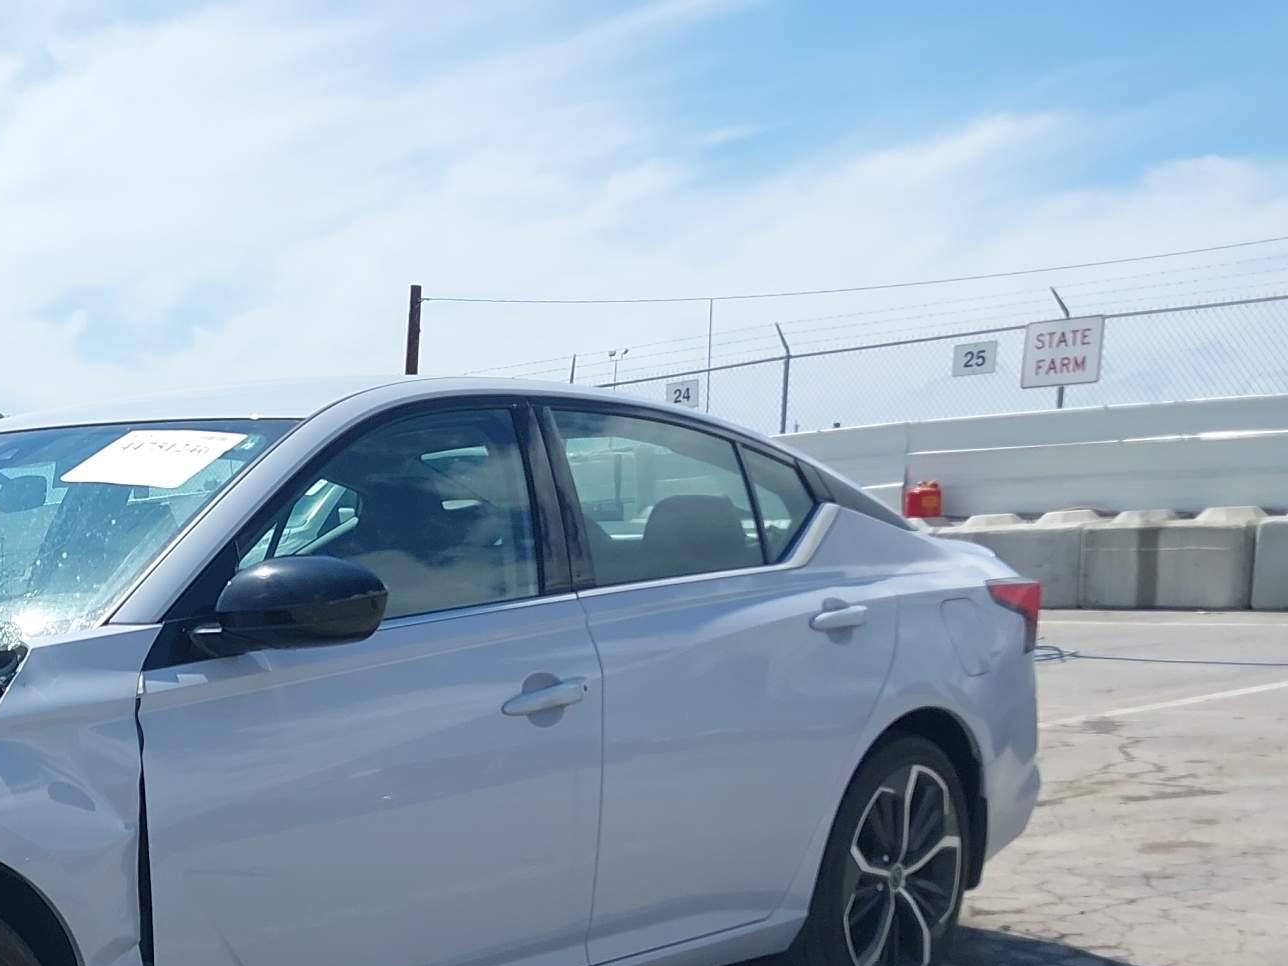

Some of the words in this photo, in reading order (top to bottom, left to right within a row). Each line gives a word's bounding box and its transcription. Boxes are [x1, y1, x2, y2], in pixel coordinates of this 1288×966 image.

[1034, 327, 1093, 350] STATE
[962, 349, 987, 368] 25
[1034, 355, 1087, 376] FARM
[673, 387, 691, 404] 24
